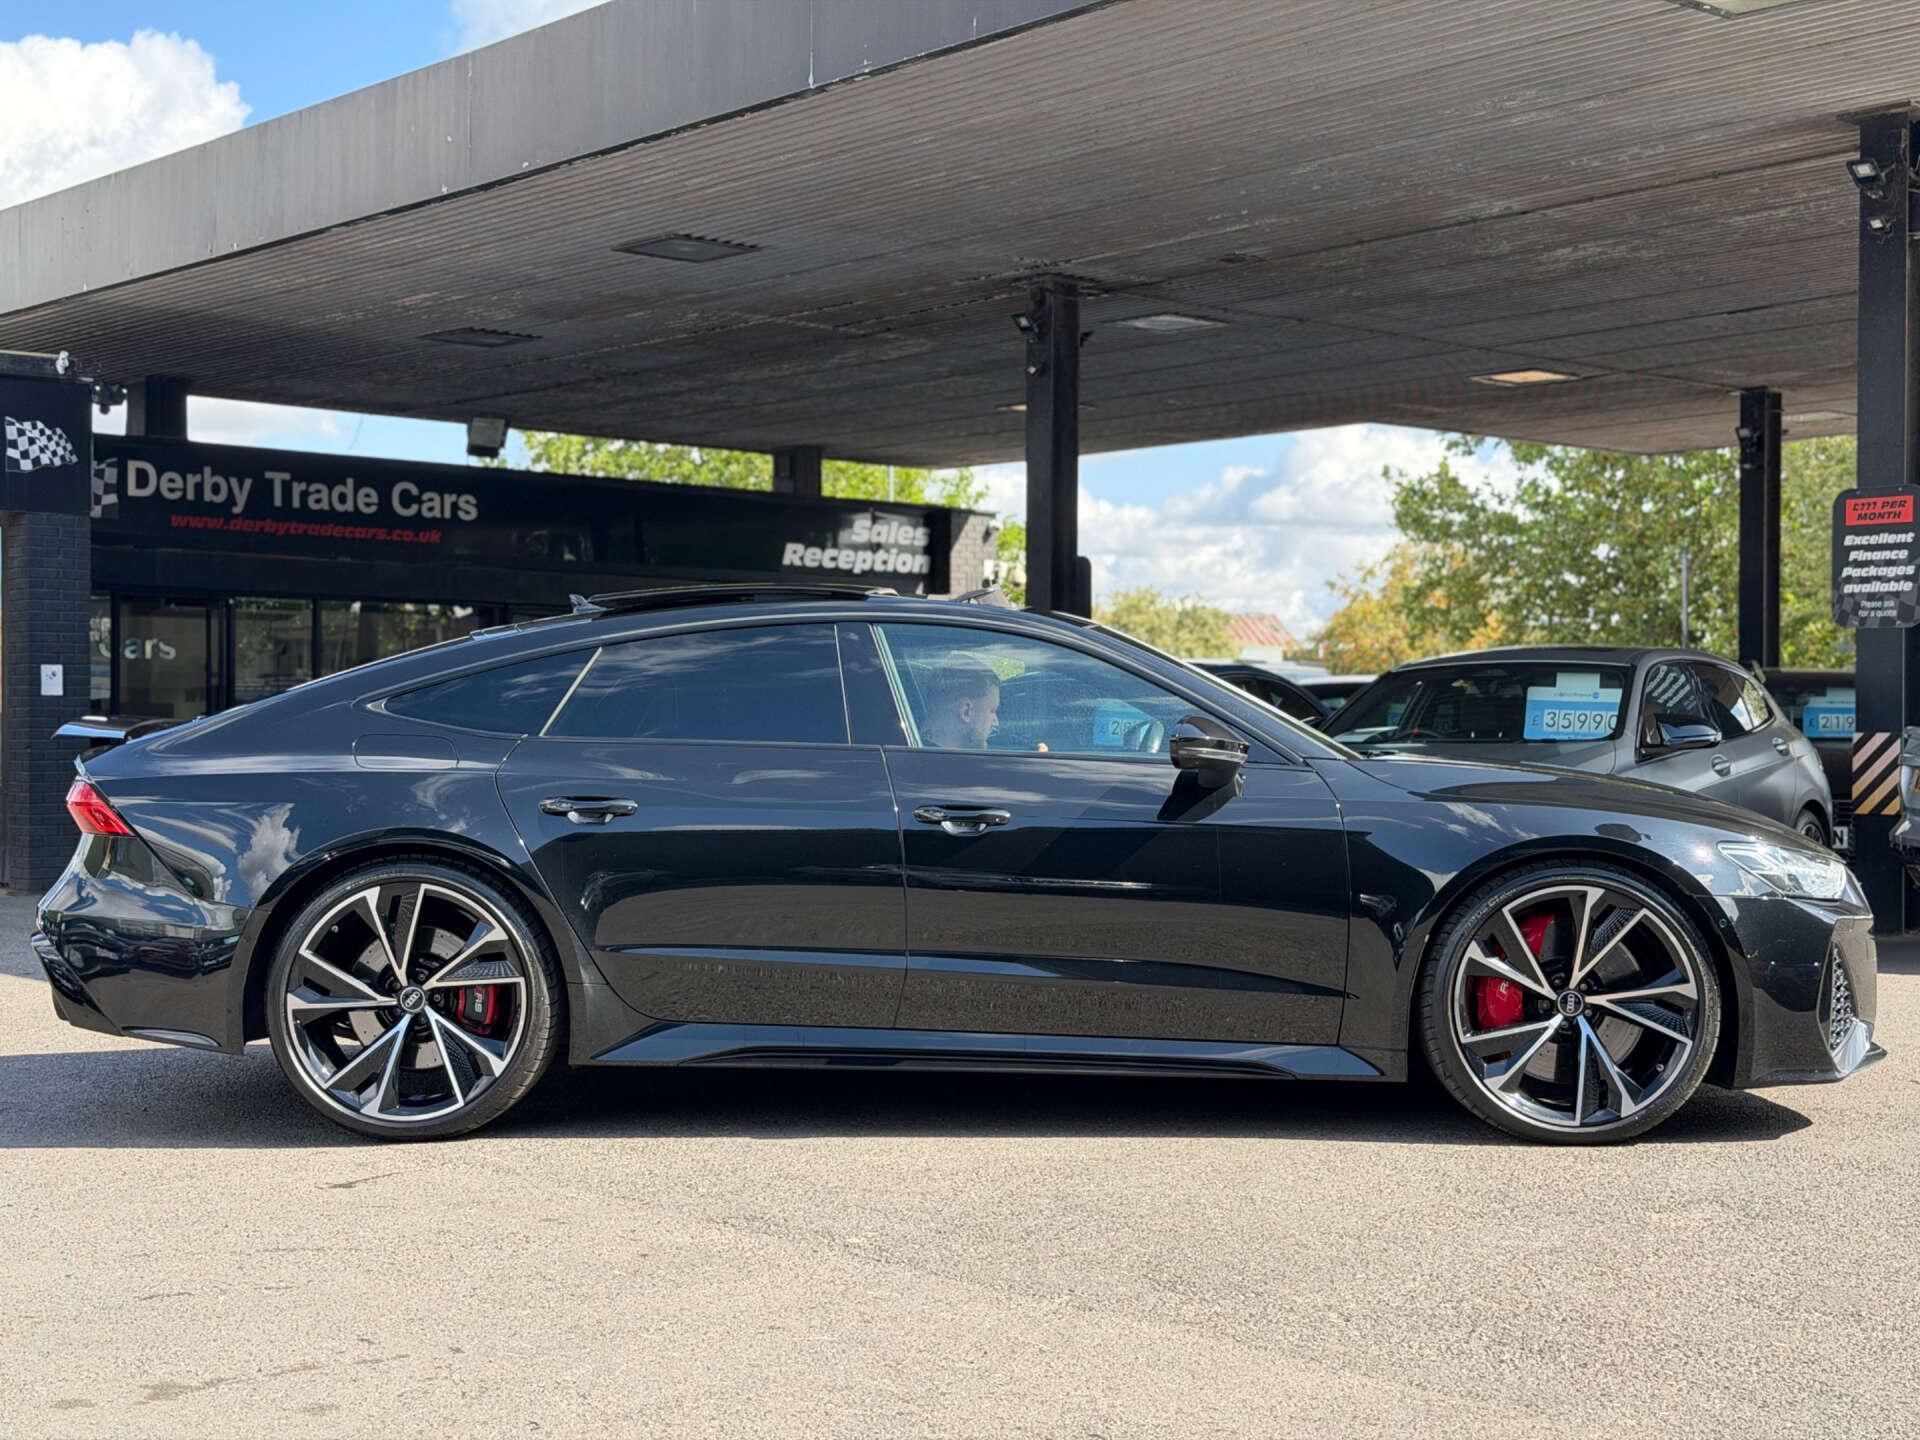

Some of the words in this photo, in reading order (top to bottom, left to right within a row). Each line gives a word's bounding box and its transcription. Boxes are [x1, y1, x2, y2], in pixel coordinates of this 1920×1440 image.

[127, 460, 253, 514] Derby
[264, 471, 379, 514] Trade
[391, 481, 478, 521] Cars
[1881, 500, 1907, 509] PER
[1857, 511, 1901, 520] MONTH
[171, 514, 442, 543] www.derbytradecars.co.uk
[851, 518, 930, 547] Sales
[1843, 532, 1916, 546] Excellent
[782, 542, 931, 574] Reception
[1848, 549, 1909, 561] Finance
[1841, 565, 1916, 577] Packages
[1843, 580, 1914, 593] available
